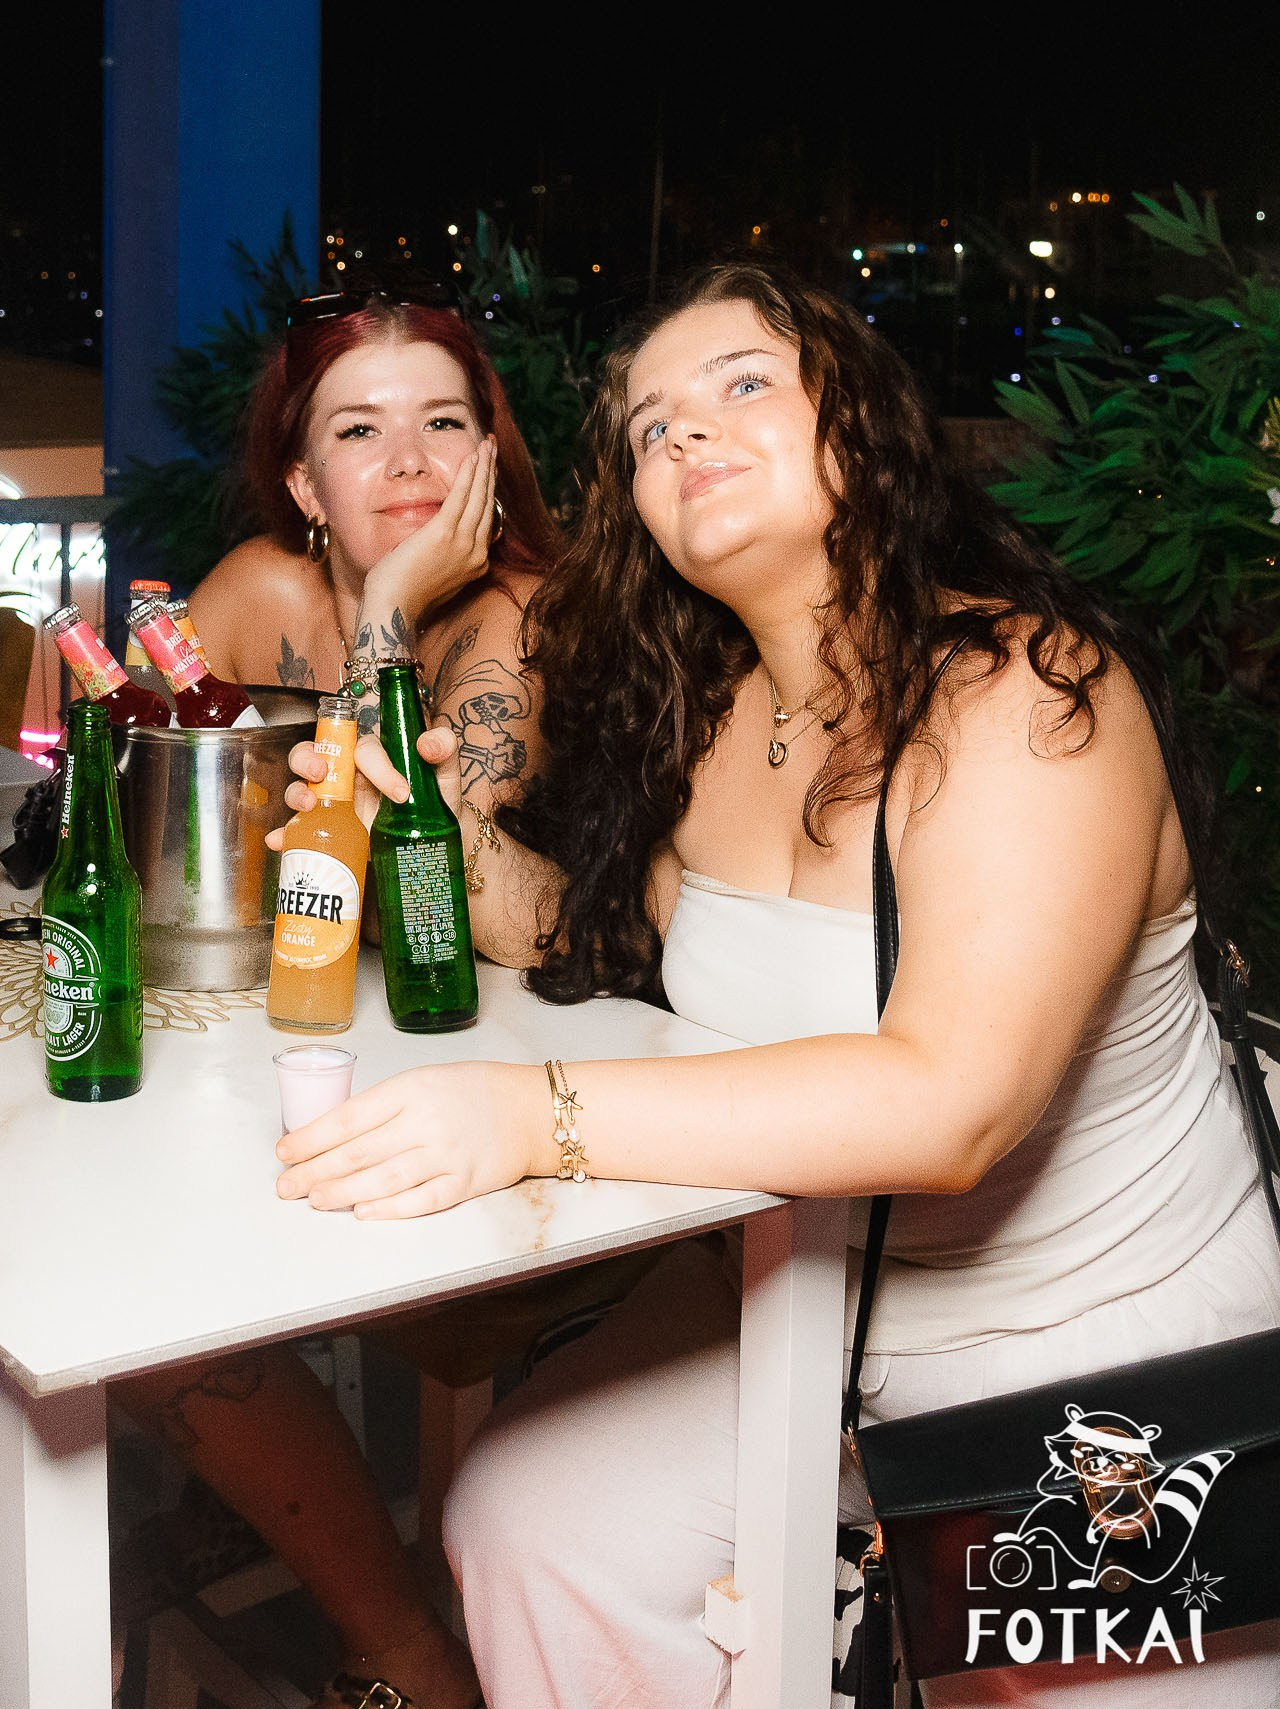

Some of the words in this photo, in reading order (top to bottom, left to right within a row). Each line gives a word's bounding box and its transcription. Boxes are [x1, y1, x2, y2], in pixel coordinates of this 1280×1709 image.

[61, 753, 75, 825] Heineken
[52, 931, 86, 971] ORIGINAL
[281, 932, 316, 947] ORANGE
[61, 1022, 86, 1047] LAGER
